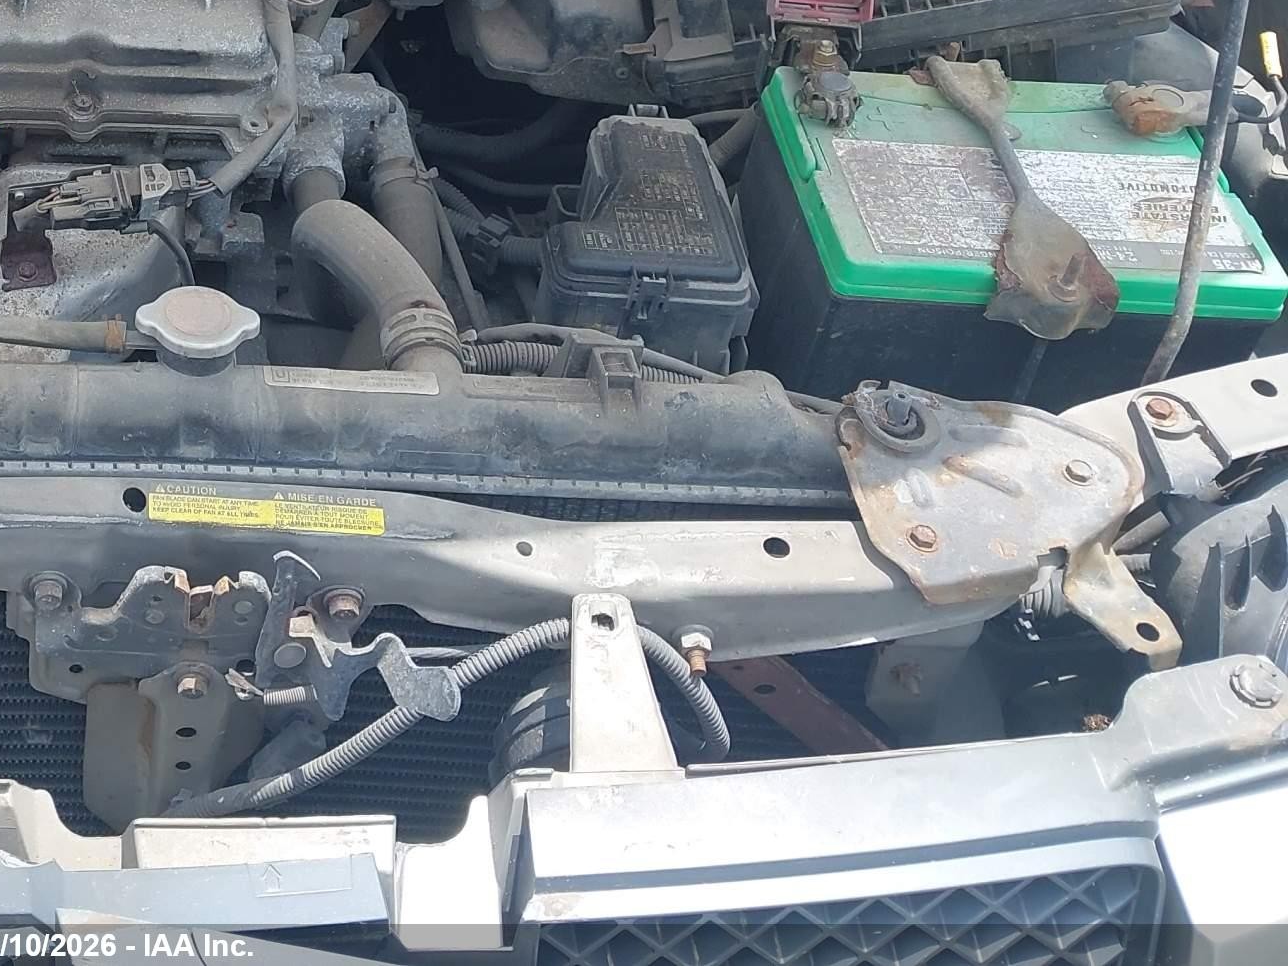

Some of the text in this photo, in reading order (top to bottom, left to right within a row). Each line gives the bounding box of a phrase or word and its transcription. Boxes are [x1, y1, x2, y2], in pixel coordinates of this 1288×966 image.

[1133, 202, 1219, 214] BTERIES
[1131, 211, 1227, 223] INRSTATE
[166, 485, 216, 496] CAUTION
[288, 492, 377, 507] MISE EN GARDE
